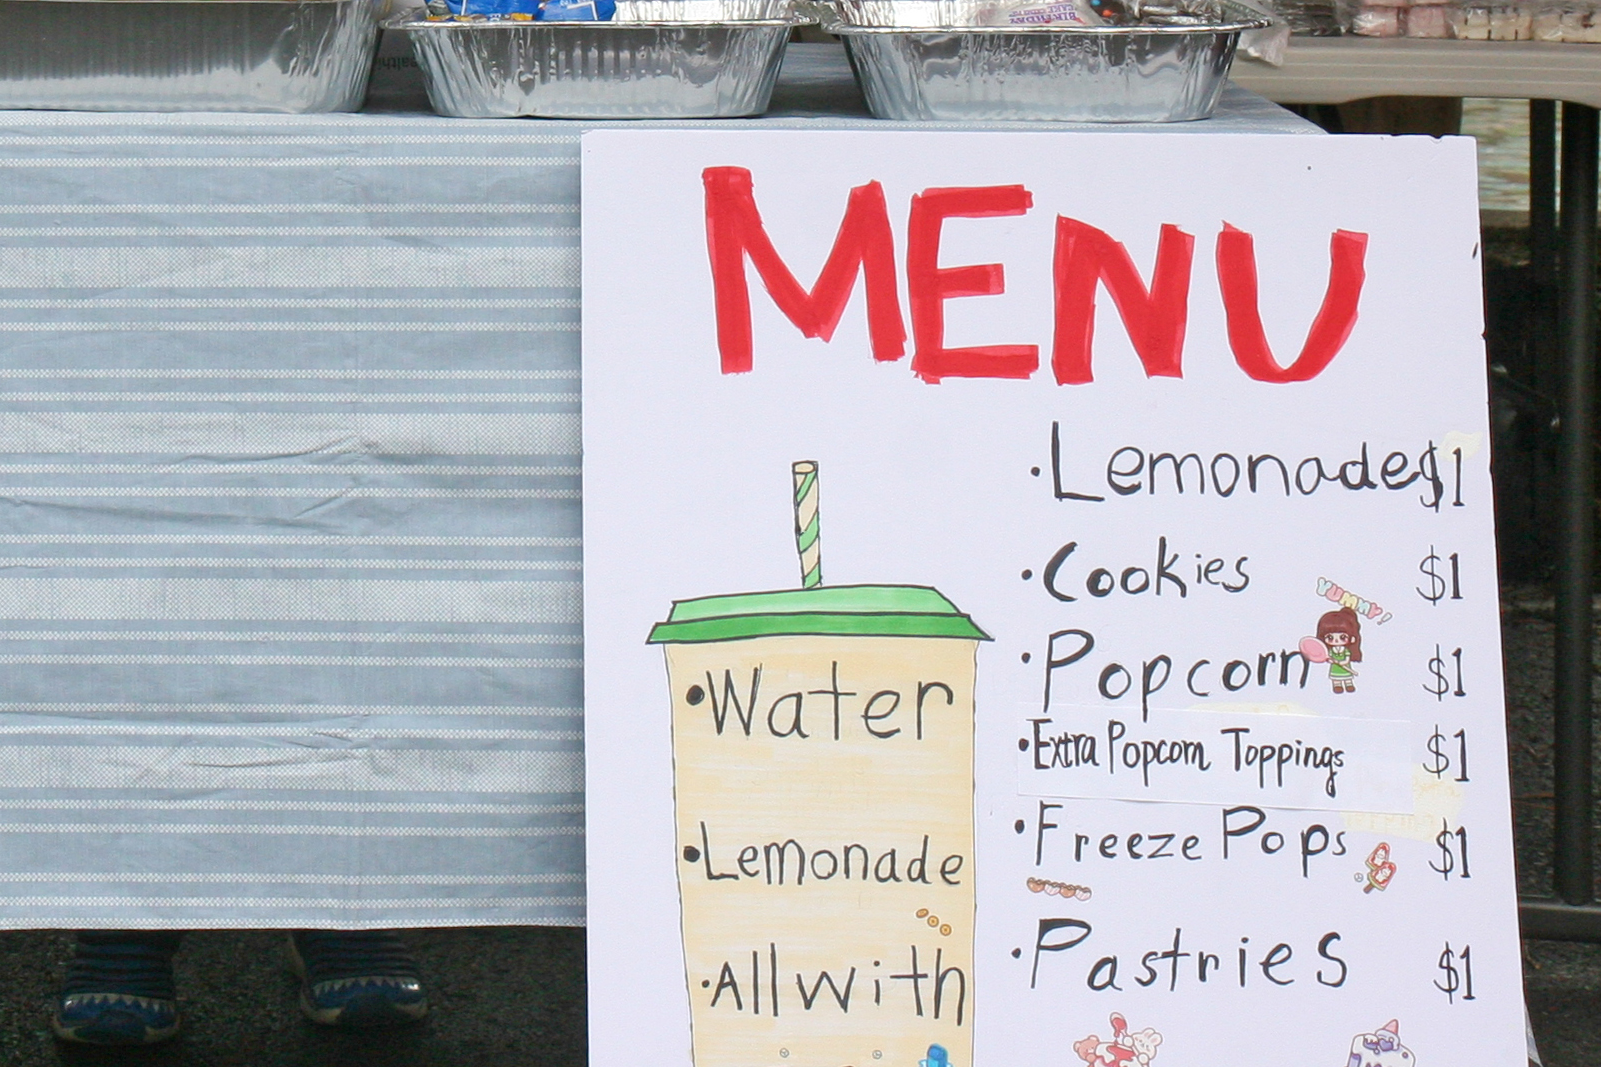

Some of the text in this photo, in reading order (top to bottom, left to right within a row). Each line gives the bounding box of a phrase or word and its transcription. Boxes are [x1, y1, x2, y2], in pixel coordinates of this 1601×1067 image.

[702, 165, 1369, 385] MENU
[1051, 419, 1466, 513] Lemonade $1
[1043, 536, 1464, 607] Cookies $1
[706, 660, 955, 742] Water
[1044, 628, 1468, 723] Popcorn $1
[1026, 717, 1101, 770] Extra
[1220, 727, 1345, 798] Toppings
[1422, 724, 1470, 782] $1
[699, 820, 964, 886] Lemonade
[1035, 799, 1203, 867] Freeze
[1222, 805, 1348, 879] Pops
[1427, 817, 1471, 881] $1
[1433, 940, 1477, 1005] $1
